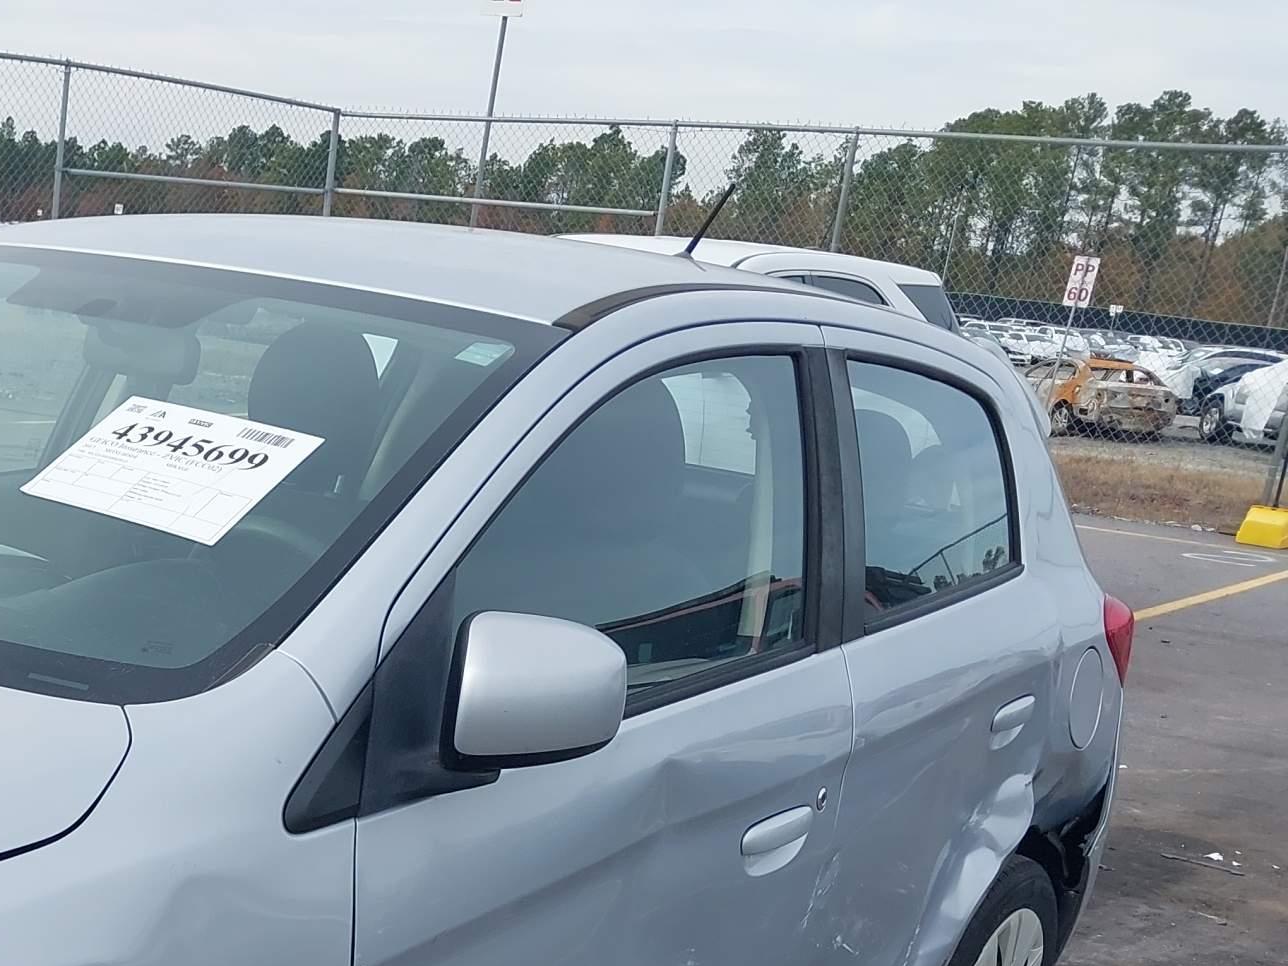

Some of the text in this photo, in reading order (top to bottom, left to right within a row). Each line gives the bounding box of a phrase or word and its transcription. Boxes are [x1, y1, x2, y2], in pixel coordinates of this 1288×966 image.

[1073, 263, 1096, 278] PP
[1067, 287, 1089, 302] 60
[112, 422, 269, 471] 43945699
